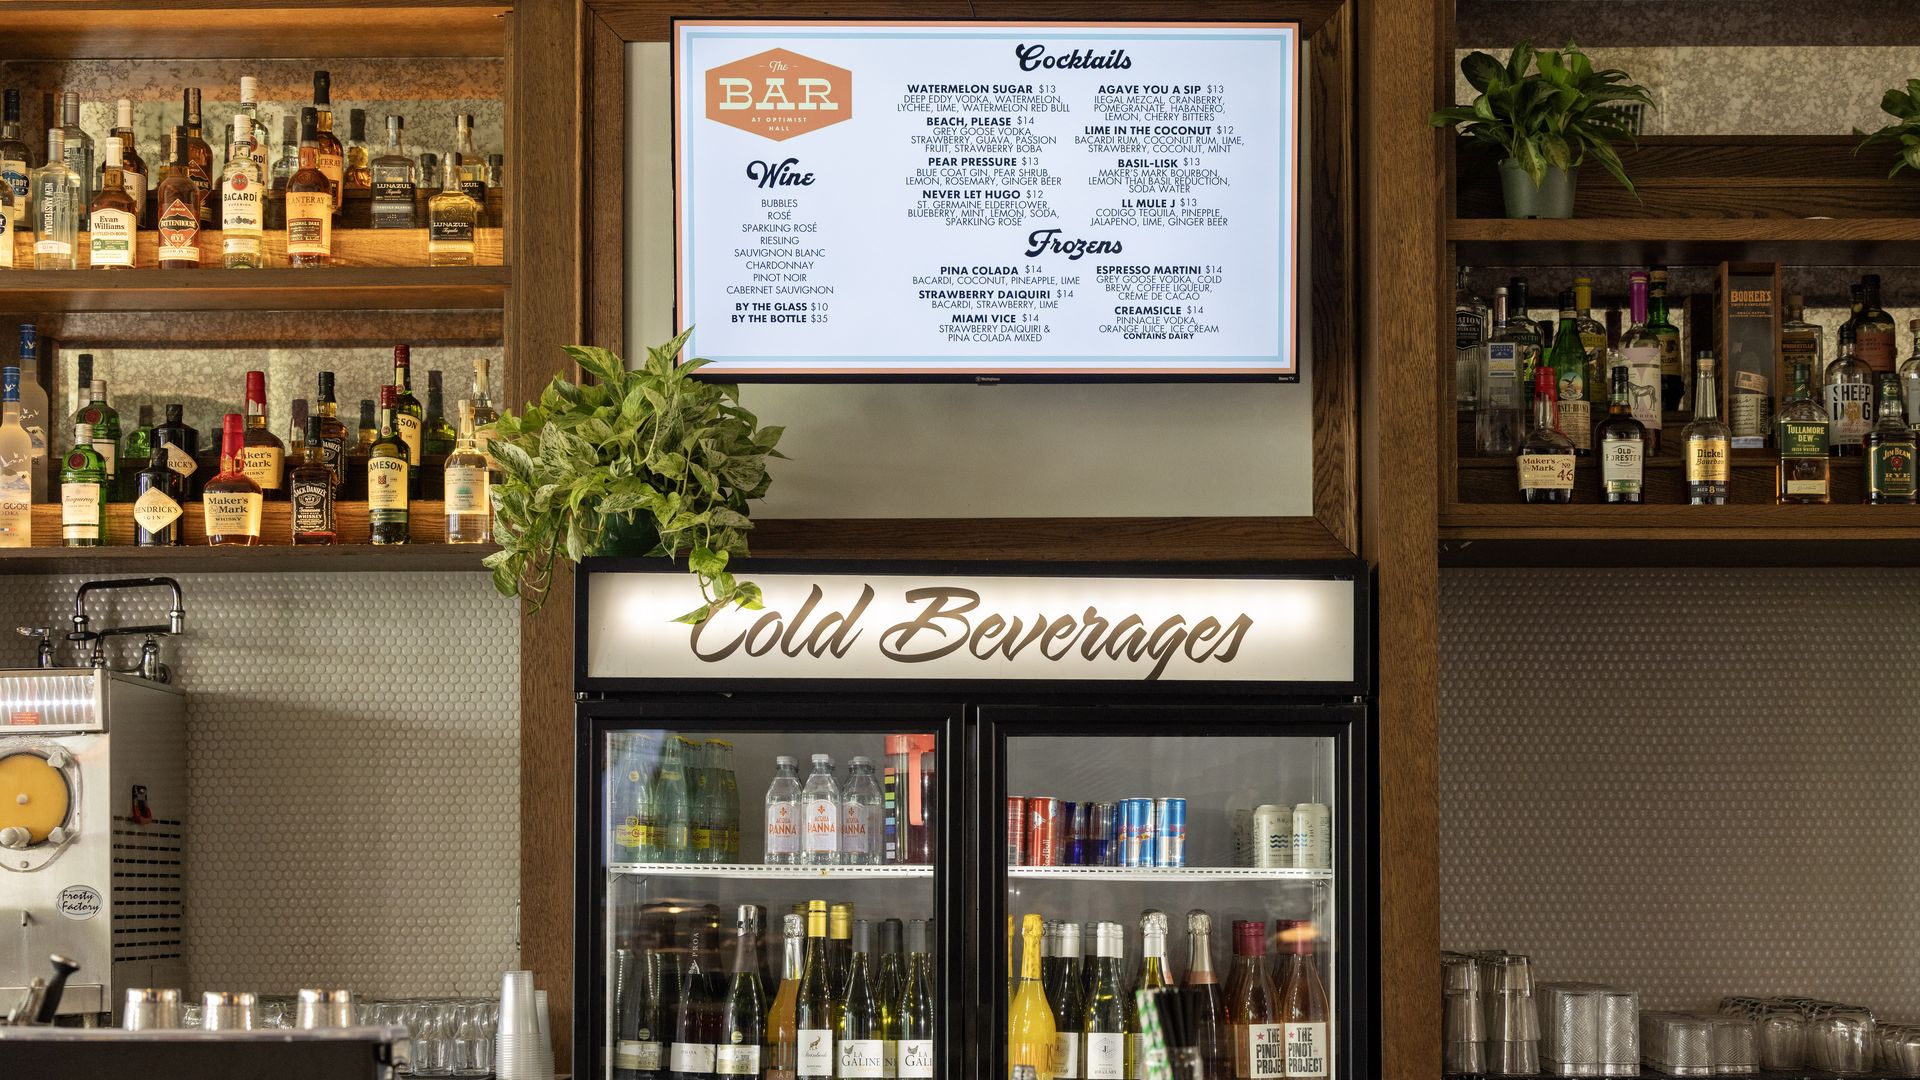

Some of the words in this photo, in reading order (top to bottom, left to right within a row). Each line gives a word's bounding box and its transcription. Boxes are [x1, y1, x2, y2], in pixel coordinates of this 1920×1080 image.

[1015, 43, 1132, 72] Cocktails
[769, 60, 788, 72] The
[719, 77, 839, 110] BAR
[907, 84, 989, 94] WATERMELON
[992, 84, 1033, 94] SUGAR
[1038, 84, 1056, 94] $13
[1098, 85, 1139, 94] AGAVE
[1142, 85, 1169, 95] YOU
[1172, 85, 1181, 94] A
[1183, 85, 1201, 95] SIP
[1207, 85, 1224, 95] $13
[926, 117, 968, 126] BEACH,
[971, 117, 1011, 126] PLEASE
[1017, 117, 1034, 125] $14
[1085, 126, 1111, 135] LIME
[1114, 126, 1127, 135] IN
[1130, 126, 1151, 135] THE
[1154, 126, 1212, 135] COCONUT
[1216, 126, 1234, 135] $12
[928, 157, 958, 166] PEAR
[961, 157, 1017, 166] PRESSURE
[1021, 157, 1039, 166] $13
[1118, 159, 1178, 168] BASIL-LISK
[1183, 157, 1200, 167] $13
[746, 158, 816, 189] Wine
[224, 191, 257, 202] BACARDÍ
[922, 190, 961, 199] NEVER
[964, 190, 982, 199] LET
[985, 190, 1021, 199] HUGO
[1026, 190, 1043, 199] $12
[761, 199, 798, 208] BUBBLES
[1122, 199, 1133, 208] LL
[1136, 199, 1167, 208] MULE
[1170, 199, 1175, 208] J
[1180, 198, 1197, 207] $13
[100, 215, 119, 223] Evan
[742, 223, 792, 233] SPARKLING
[760, 236, 800, 245] RIESLING
[1024, 228, 1123, 260] Frozens
[734, 249, 793, 257] SAUVIGNON
[795, 249, 825, 257] BLANC
[745, 261, 814, 270] CHARDONNAY
[940, 266, 969, 275] PINA
[971, 266, 1019, 275] COLADA
[1025, 265, 1042, 274] $14
[1096, 265, 1151, 275] ESPRESSO
[1153, 266, 1201, 275] MARTINI
[1205, 265, 1222, 275] $14
[753, 273, 781, 282] PINOT
[783, 273, 807, 282] NOIR
[726, 285, 773, 294] CABERNET
[775, 285, 834, 295] SAUVIGNON
[918, 290, 994, 299] STRAWBERRY
[998, 290, 1050, 299] DAIQUIRI
[1057, 289, 1073, 299] $14
[1730, 290, 1772, 303] BOOKER'S
[735, 302, 750, 311] BY
[752, 302, 771, 311] THE
[774, 302, 808, 311] GLASS
[811, 302, 828, 311] $10
[1114, 306, 1182, 315] CREAMSICLE
[1187, 306, 1203, 315] $14
[731, 314, 746, 323] BY
[748, 314, 767, 323] THE
[770, 314, 807, 323] BOTTLE
[811, 314, 828, 323] $35
[951, 314, 988, 323] MIAMI
[991, 314, 1016, 323] VICE
[1022, 313, 1039, 323] $14
[1833, 385, 1871, 402] SHEEP
[1787, 425, 1825, 435] TULLAMORE
[1797, 434, 1814, 442] DEW
[1697, 448, 1724, 458] Dickel
[1883, 450, 1894, 460] JIM
[1894, 448, 1911, 459] BEAM
[1522, 457, 1556, 465] Maker's
[1531, 464, 1555, 472] Mark
[1557, 469, 1573, 481] 46
[208, 496, 249, 505] Maker's
[3, 502, 28, 511] GOOSE
[218, 505, 248, 513] Mark
[690, 583, 874, 664] Cold
[879, 586, 1254, 681] Beverages
[769, 823, 797, 834] PANNA
[807, 822, 836, 833] PANNA
[62, 890, 93, 904] Frosty
[62, 901, 100, 915] Factory
[1267, 1028, 1280, 1043] THE
[1297, 1027, 1313, 1042] THE
[1256, 1043, 1280, 1058] PINOT
[1288, 1042, 1313, 1058] PINOT
[1288, 1058, 1323, 1073] PROJECT
